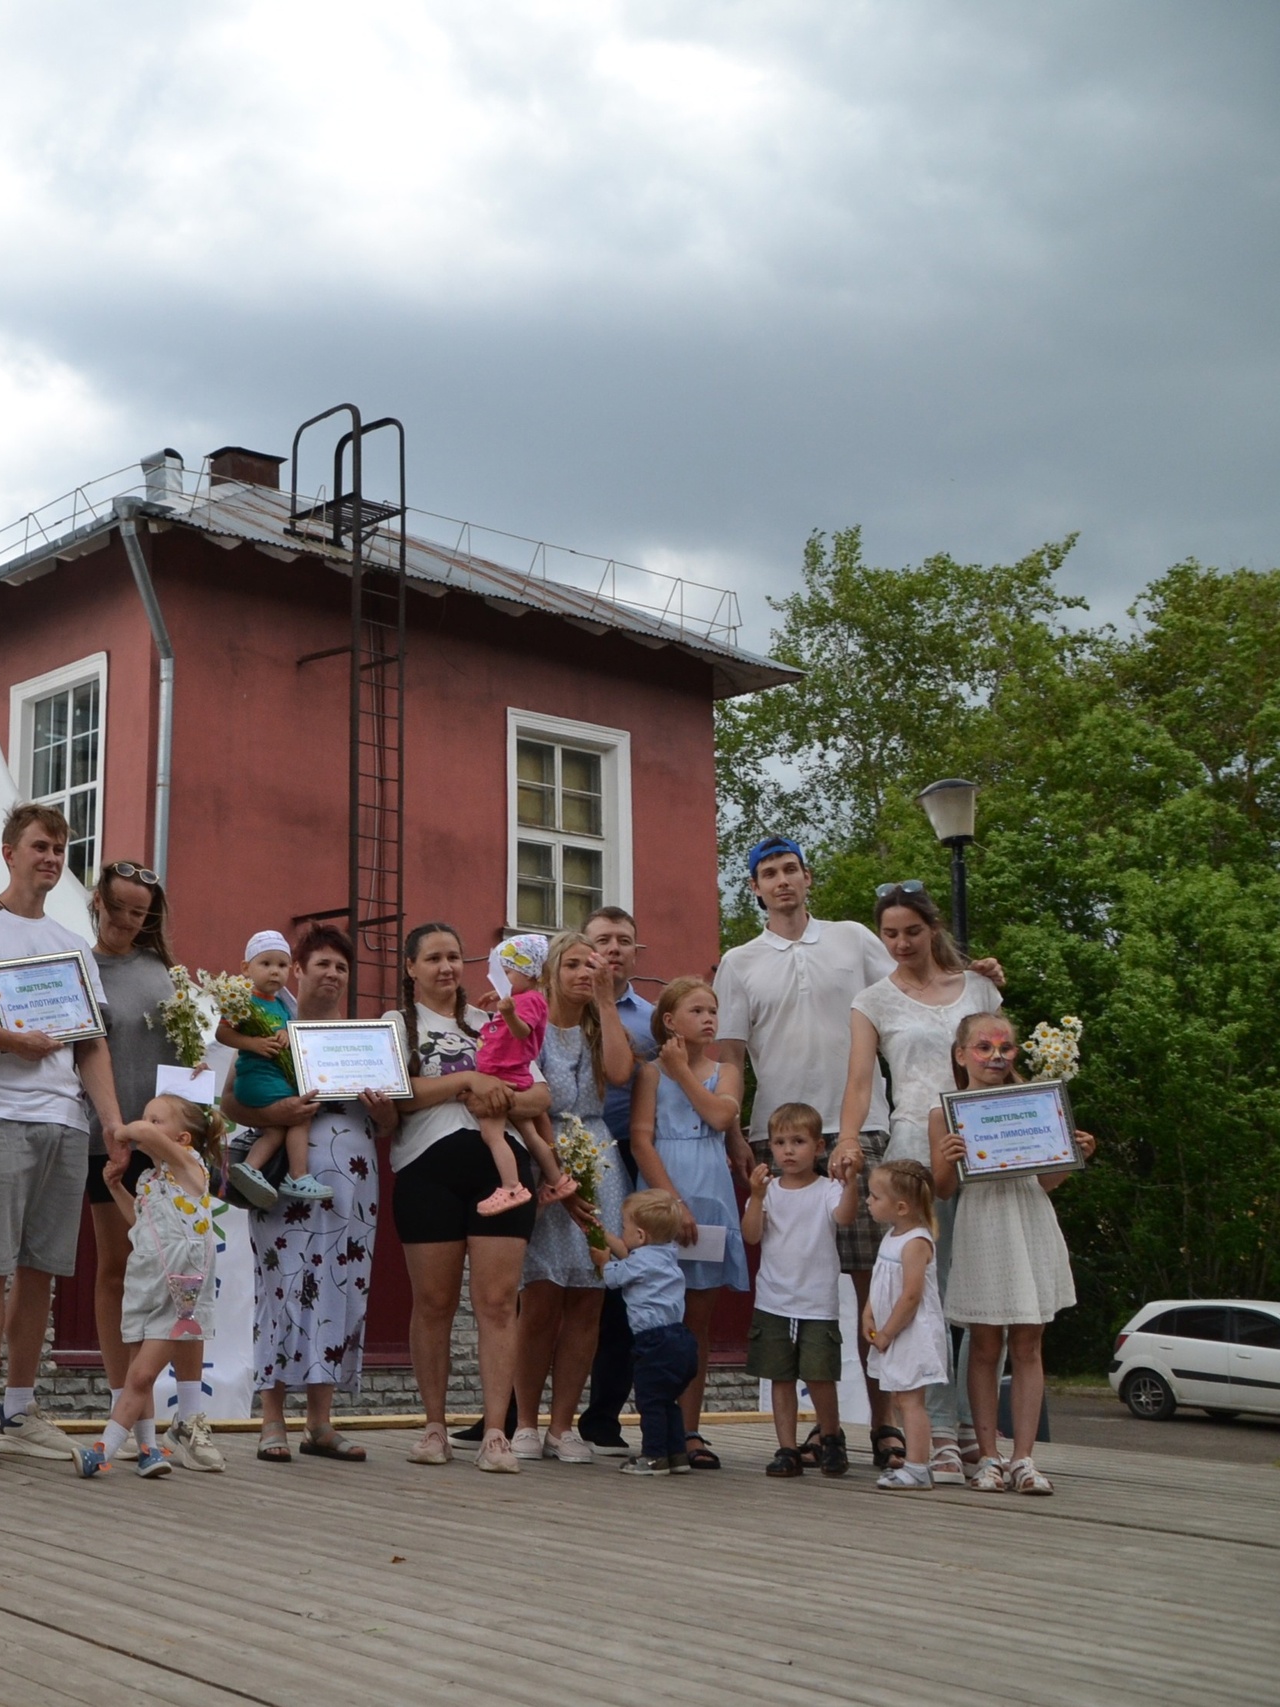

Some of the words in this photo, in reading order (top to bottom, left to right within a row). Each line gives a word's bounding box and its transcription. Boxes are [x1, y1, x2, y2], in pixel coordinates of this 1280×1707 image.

[16, 981, 62, 993] СВИДЕТЕЛЬСТВО
[8, 1003, 28, 1011] Семьи
[30, 995, 79, 1008] ПЛОТНИКОВЫХ
[322, 1044, 373, 1053] СВИДЕТЕЛЬСТВО
[317, 1060, 339, 1068] Семьи
[981, 1111, 1037, 1123] СВИДЕТЕЛЬСТВО
[1000, 1127, 1052, 1138] ЛИМОНОВЫХ
